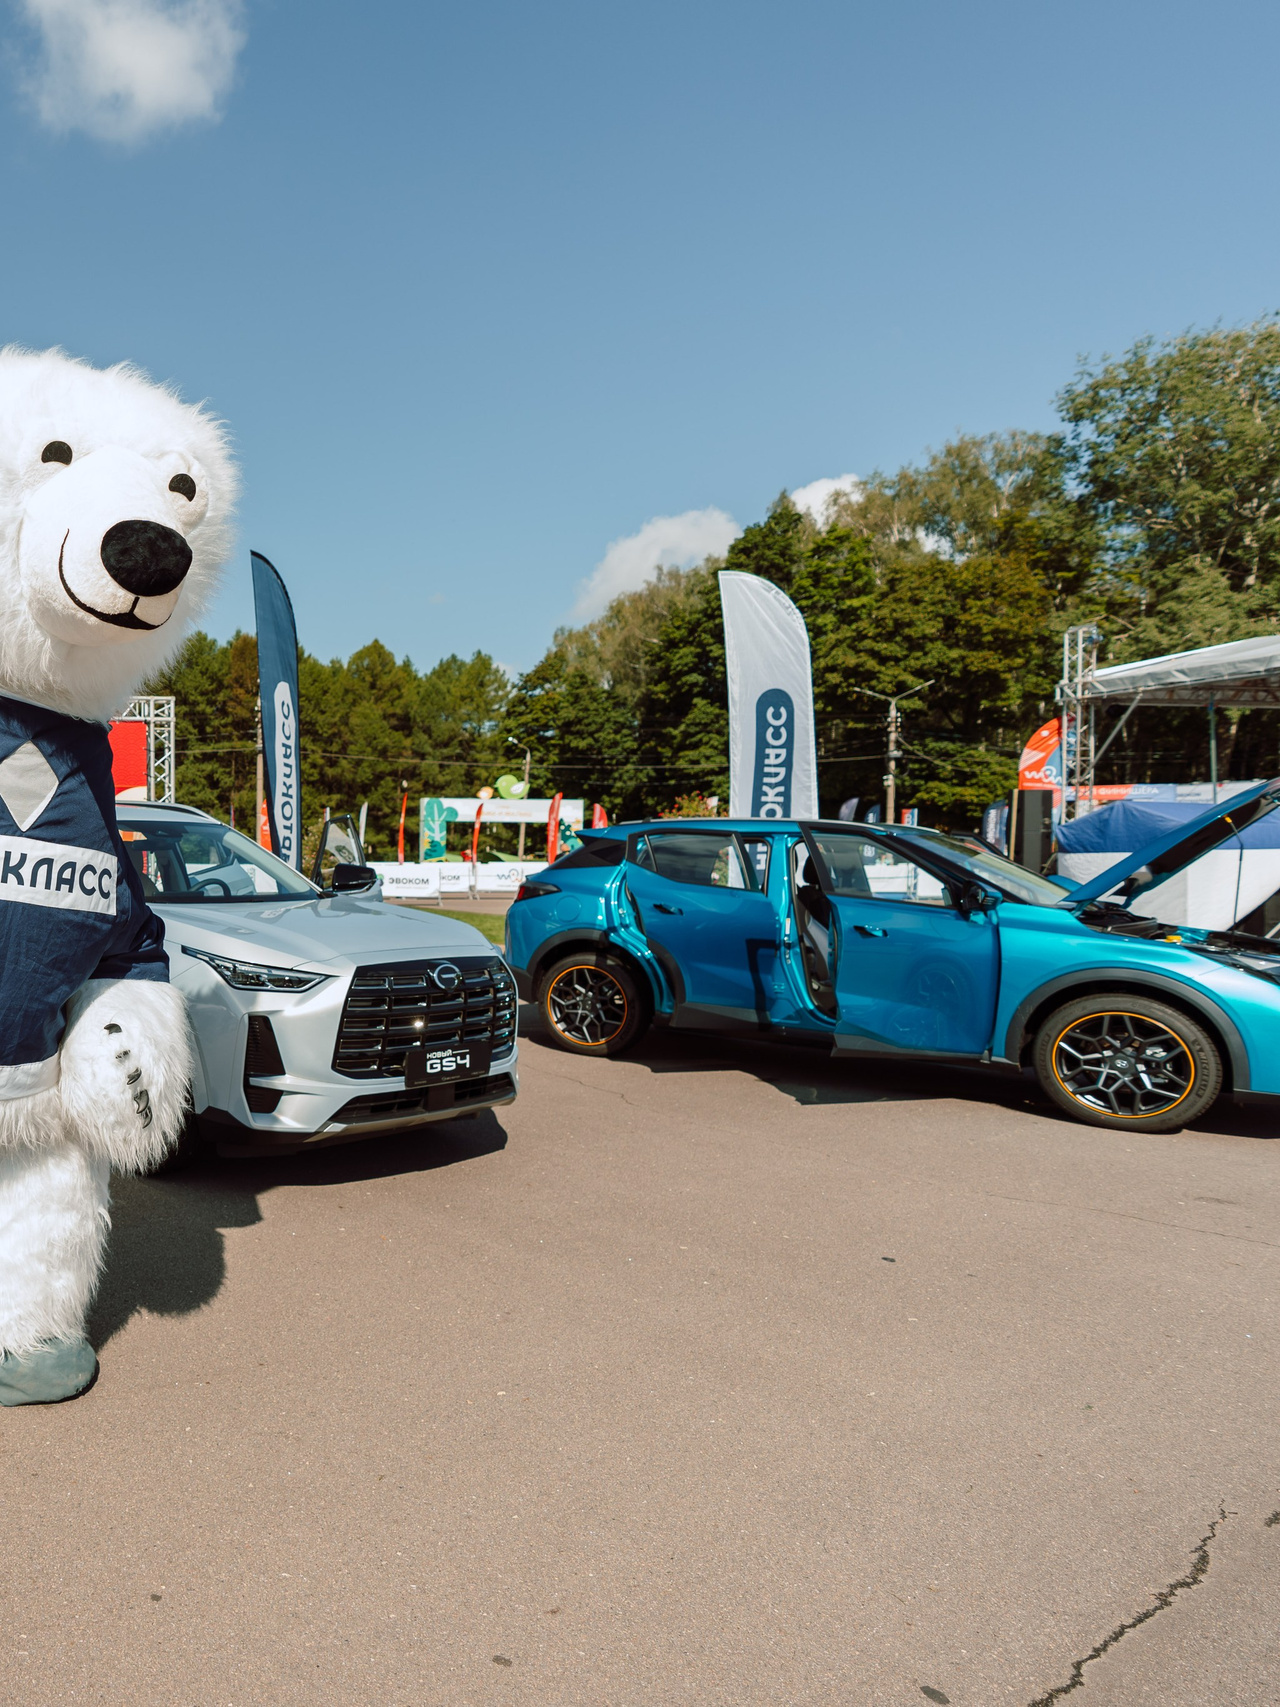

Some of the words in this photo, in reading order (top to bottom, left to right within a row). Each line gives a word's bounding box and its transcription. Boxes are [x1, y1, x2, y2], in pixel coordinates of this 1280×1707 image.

[388, 877, 429, 885] ЭВОКОМ
[426, 1049, 453, 1059] НОВЫЙ
[426, 1054, 470, 1073] GS4
